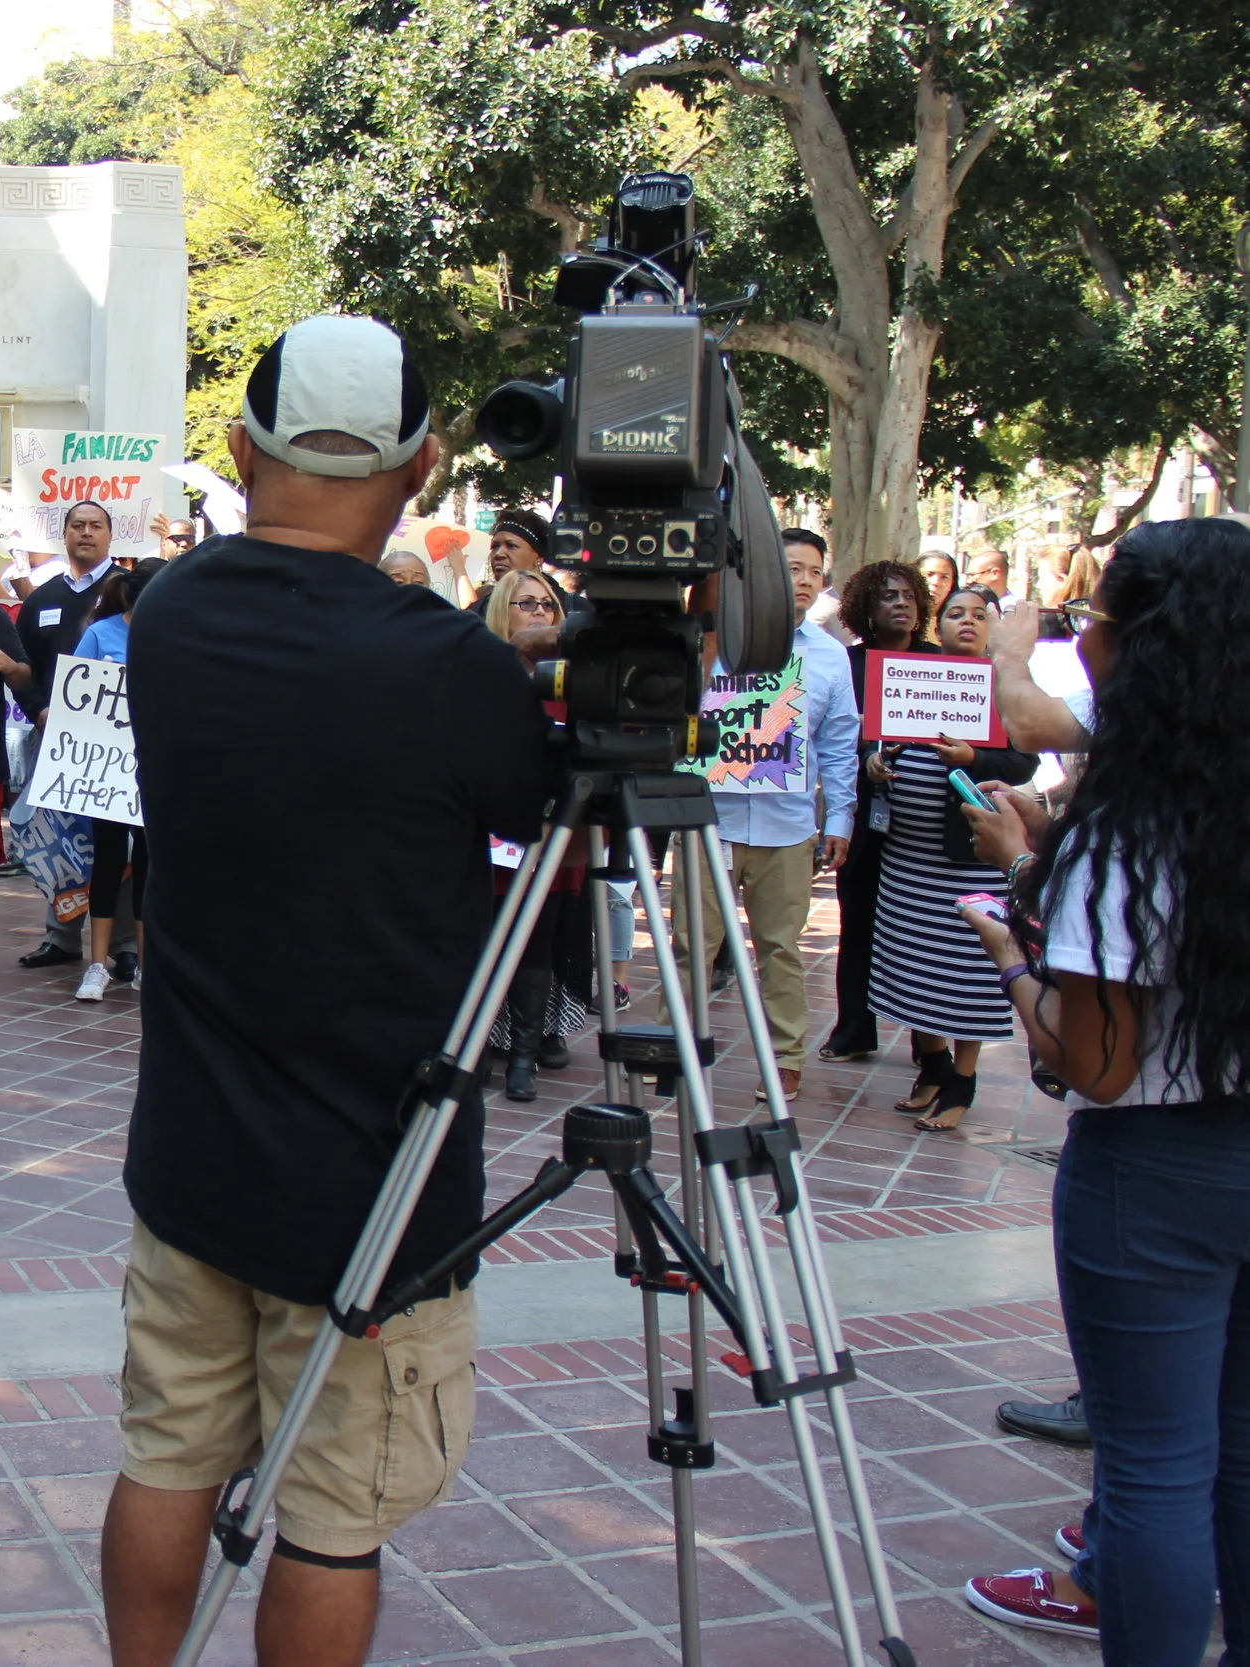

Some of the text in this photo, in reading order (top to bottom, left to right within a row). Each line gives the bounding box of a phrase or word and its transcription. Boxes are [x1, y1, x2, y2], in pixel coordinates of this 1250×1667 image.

[14, 431, 159, 466] LA FAMILIES
[603, 429, 678, 447] DIONIC
[39, 468, 141, 502] SUPPORT
[887, 666, 985, 682] Governor Brown
[884, 688, 986, 705] CA Families Rely
[888, 709, 981, 723] on After School
[50, 731, 139, 783] Suppo
[719, 731, 792, 765] School
[40, 772, 127, 811] After
